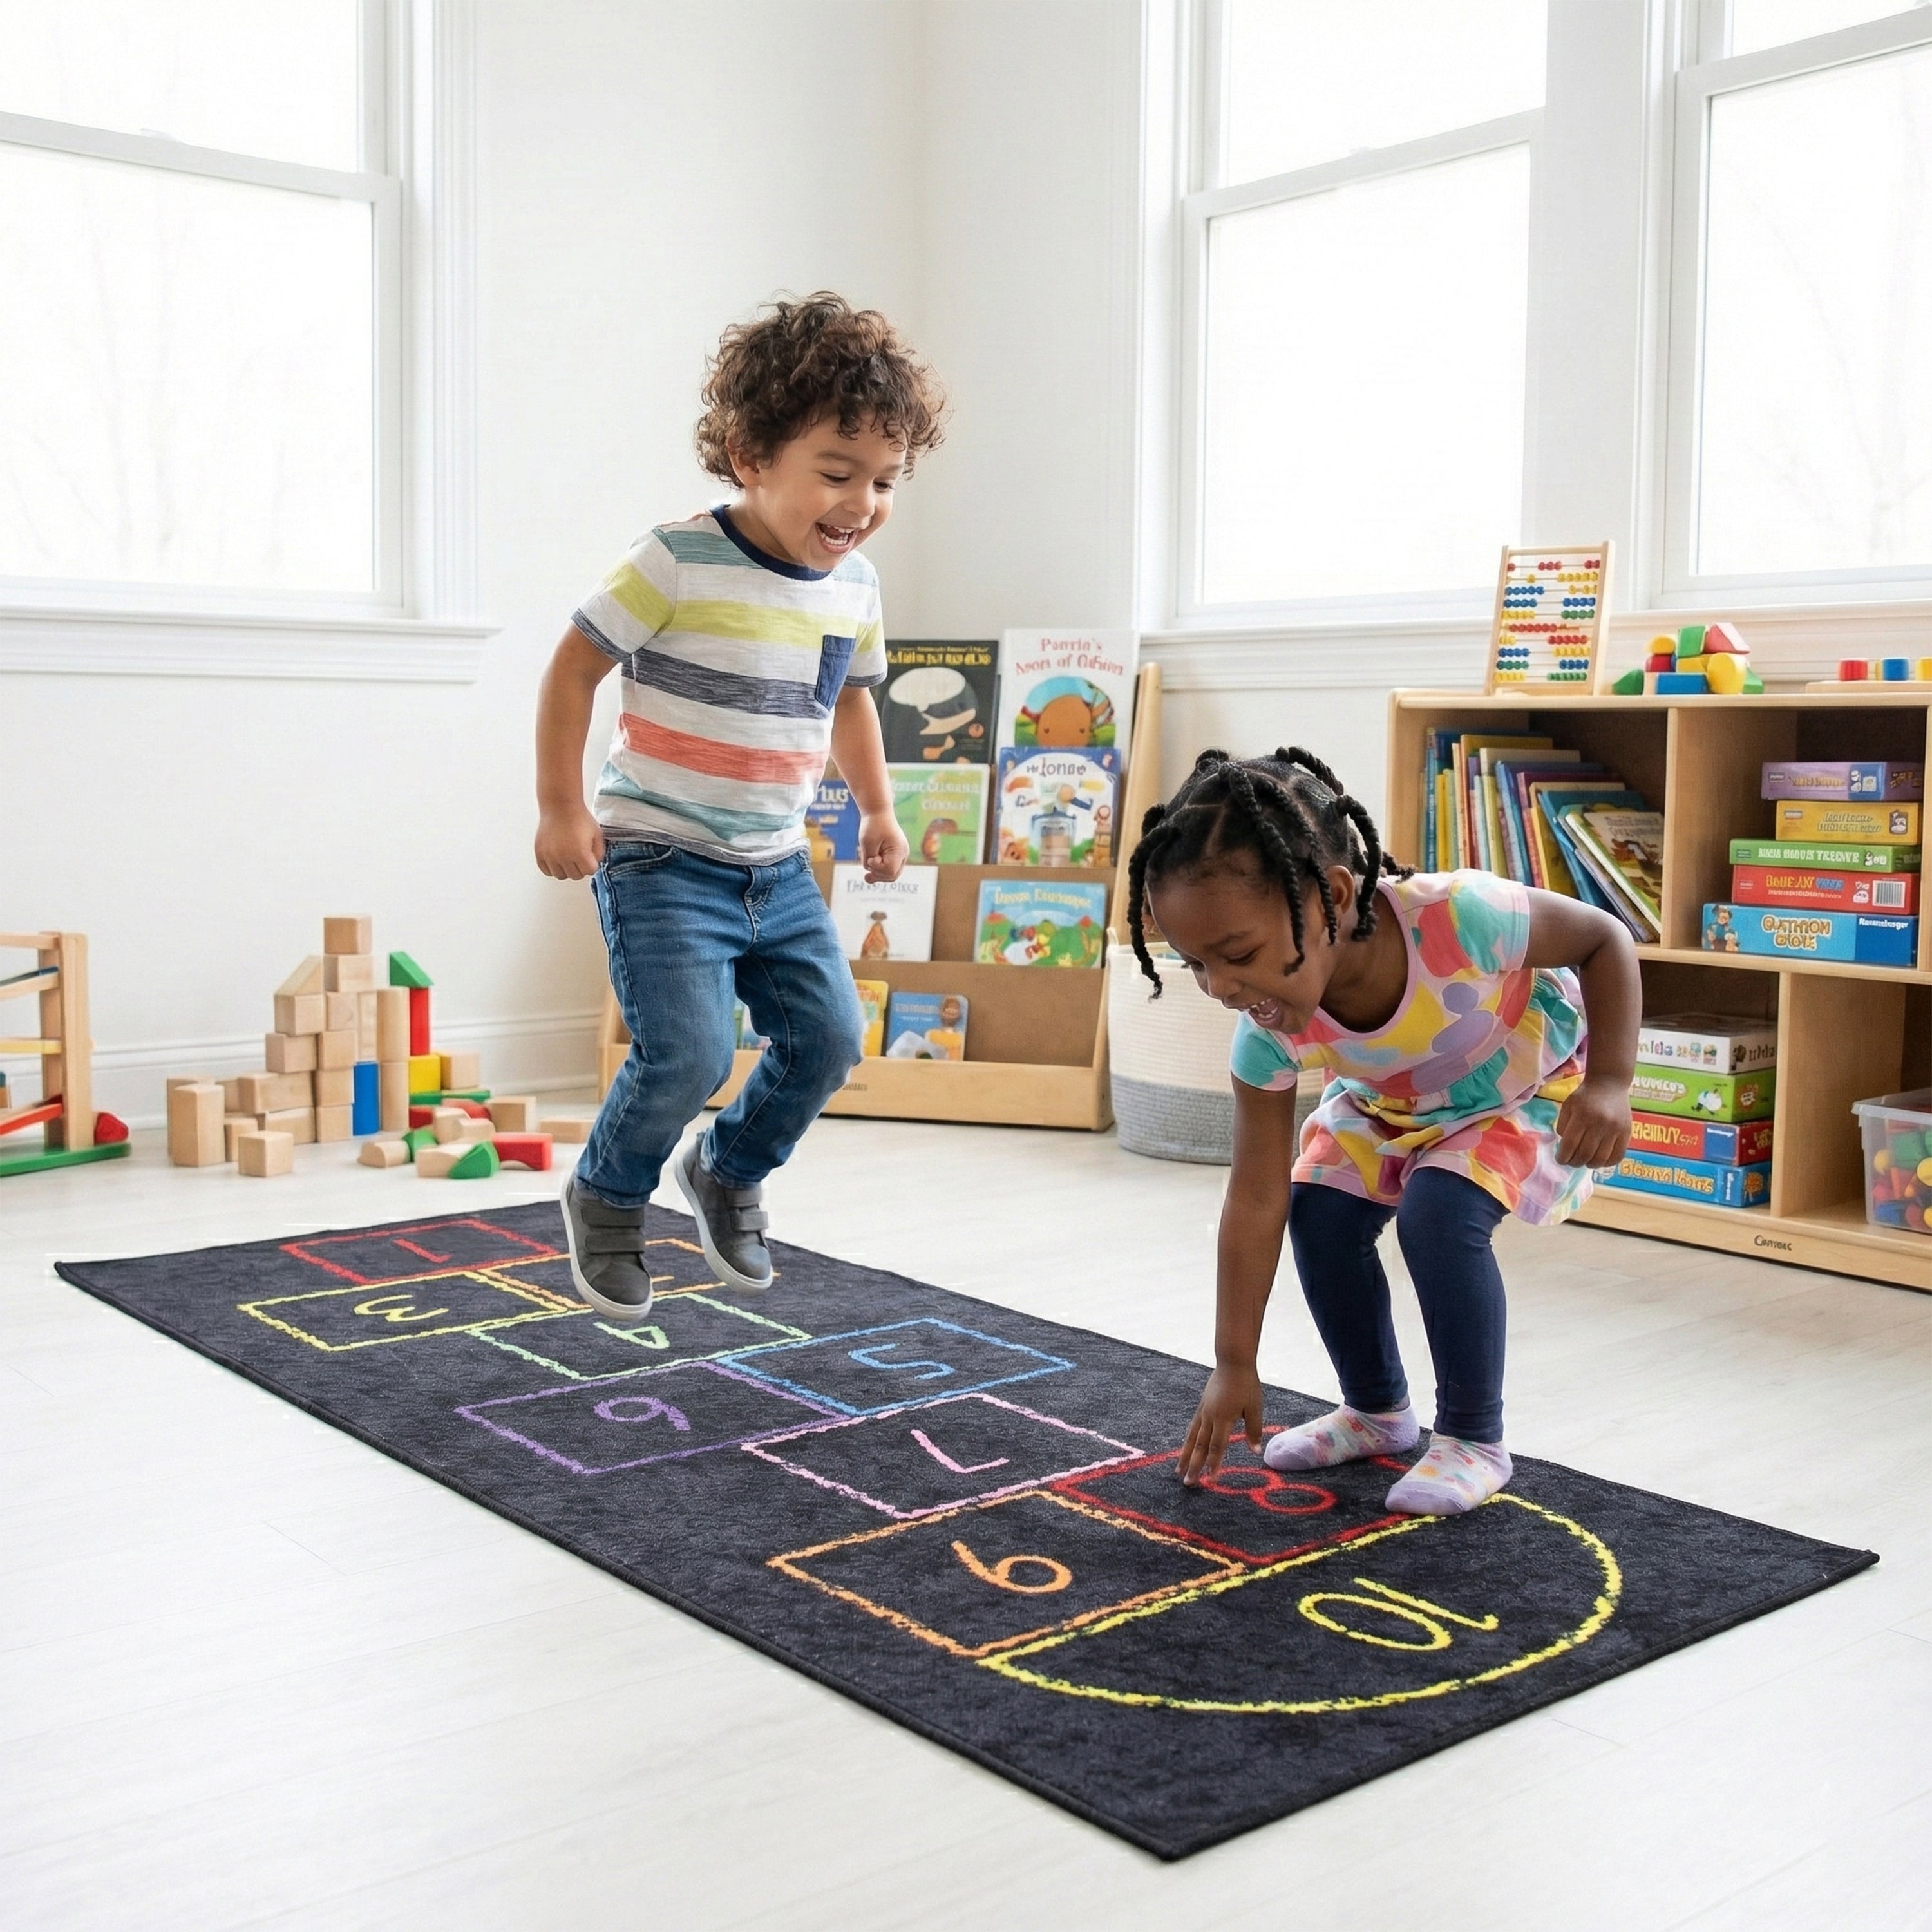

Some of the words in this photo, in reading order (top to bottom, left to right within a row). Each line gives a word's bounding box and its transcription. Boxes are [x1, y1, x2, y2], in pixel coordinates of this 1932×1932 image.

[393, 1237, 451, 1264] 1
[354, 1294, 449, 1322] 3
[593, 1321, 670, 1349] 4
[848, 1342, 957, 1381] 5
[594, 1396, 691, 1431] 6
[910, 1428, 1010, 1474] 7
[1198, 1466, 1338, 1515] 8
[952, 1541, 1074, 1595] 9
[1297, 1577, 1500, 1652] 10
